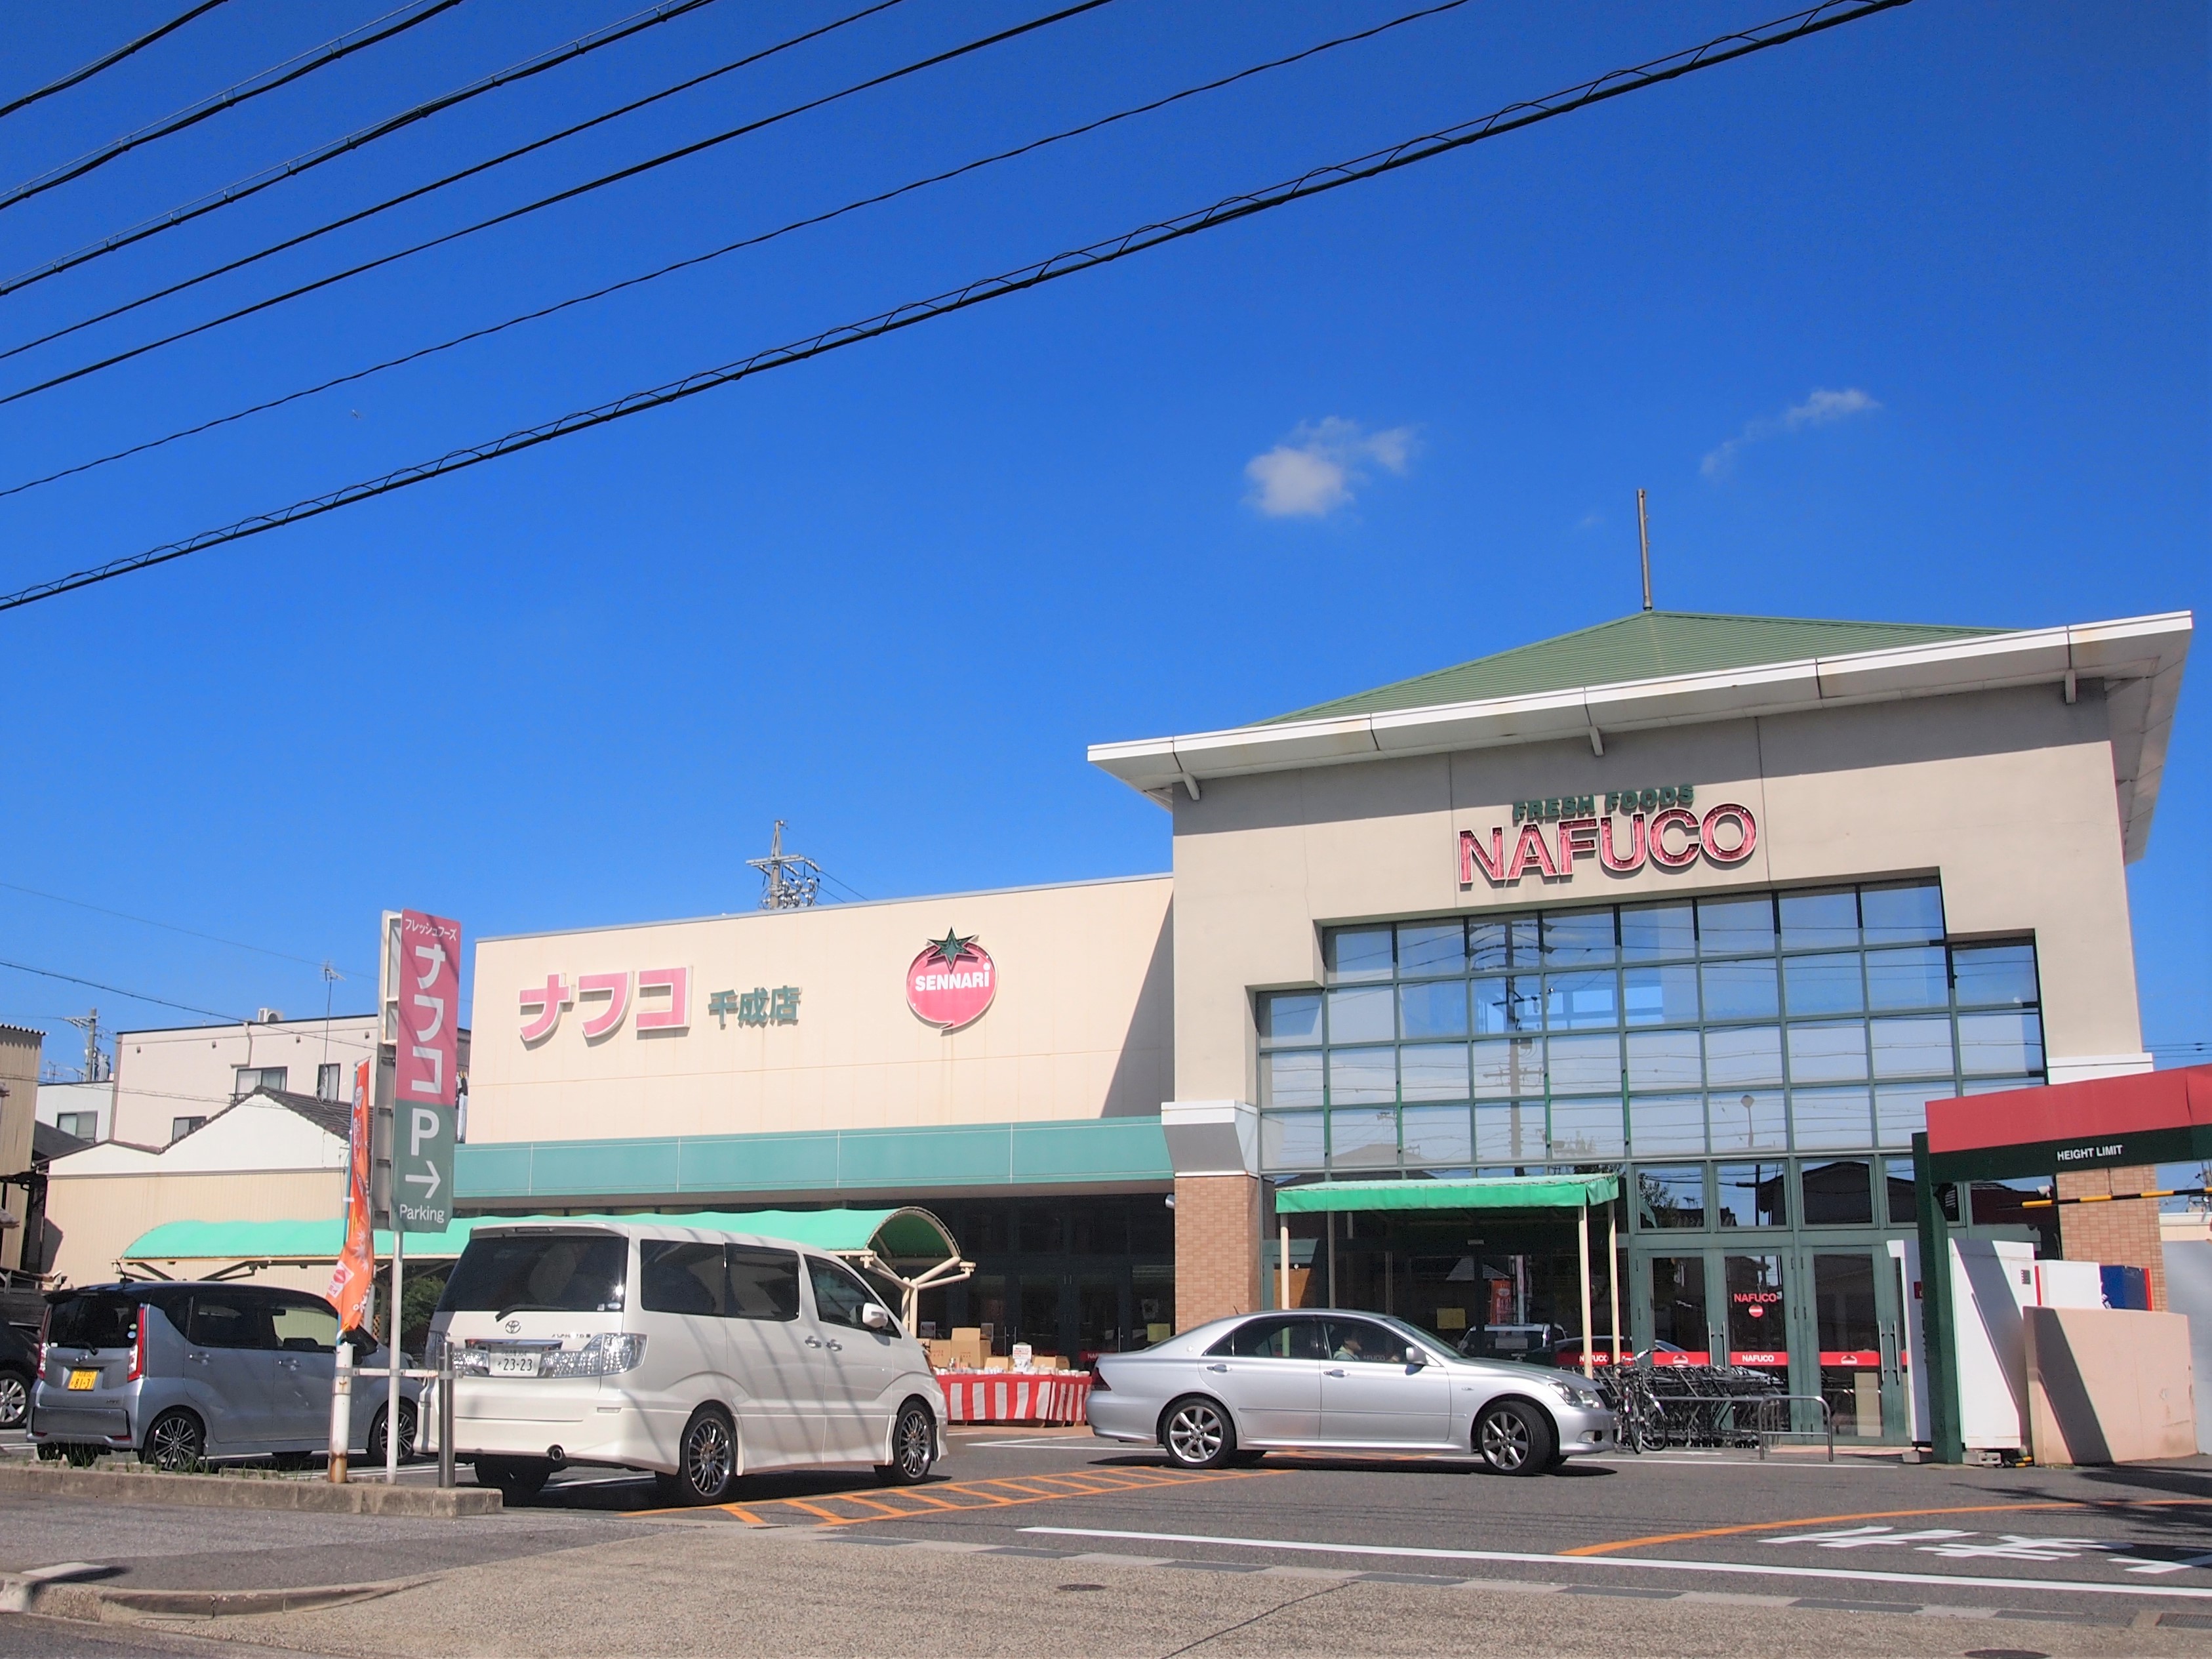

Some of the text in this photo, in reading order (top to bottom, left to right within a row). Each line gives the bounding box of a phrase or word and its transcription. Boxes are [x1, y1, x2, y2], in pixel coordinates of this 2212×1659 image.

[1512, 785, 1695, 821] FRESH FOODS
[1458, 802, 1758, 884] NAFUCO
[405, 918, 458, 941] フレッシュフーズ
[519, 966, 801, 1042] ナフコ 千成店
[411, 943, 446, 1094] ナフコ
[411, 1109, 440, 1157] P
[2056, 1144, 2123, 1161] HEIGHT LIMIT
[399, 1204, 445, 1224] Parking
[1733, 1292, 1777, 1303] NAFUCO
[1579, 1354, 1609, 1362] NFUCO
[1742, 1354, 1775, 1362] NAFUCO
